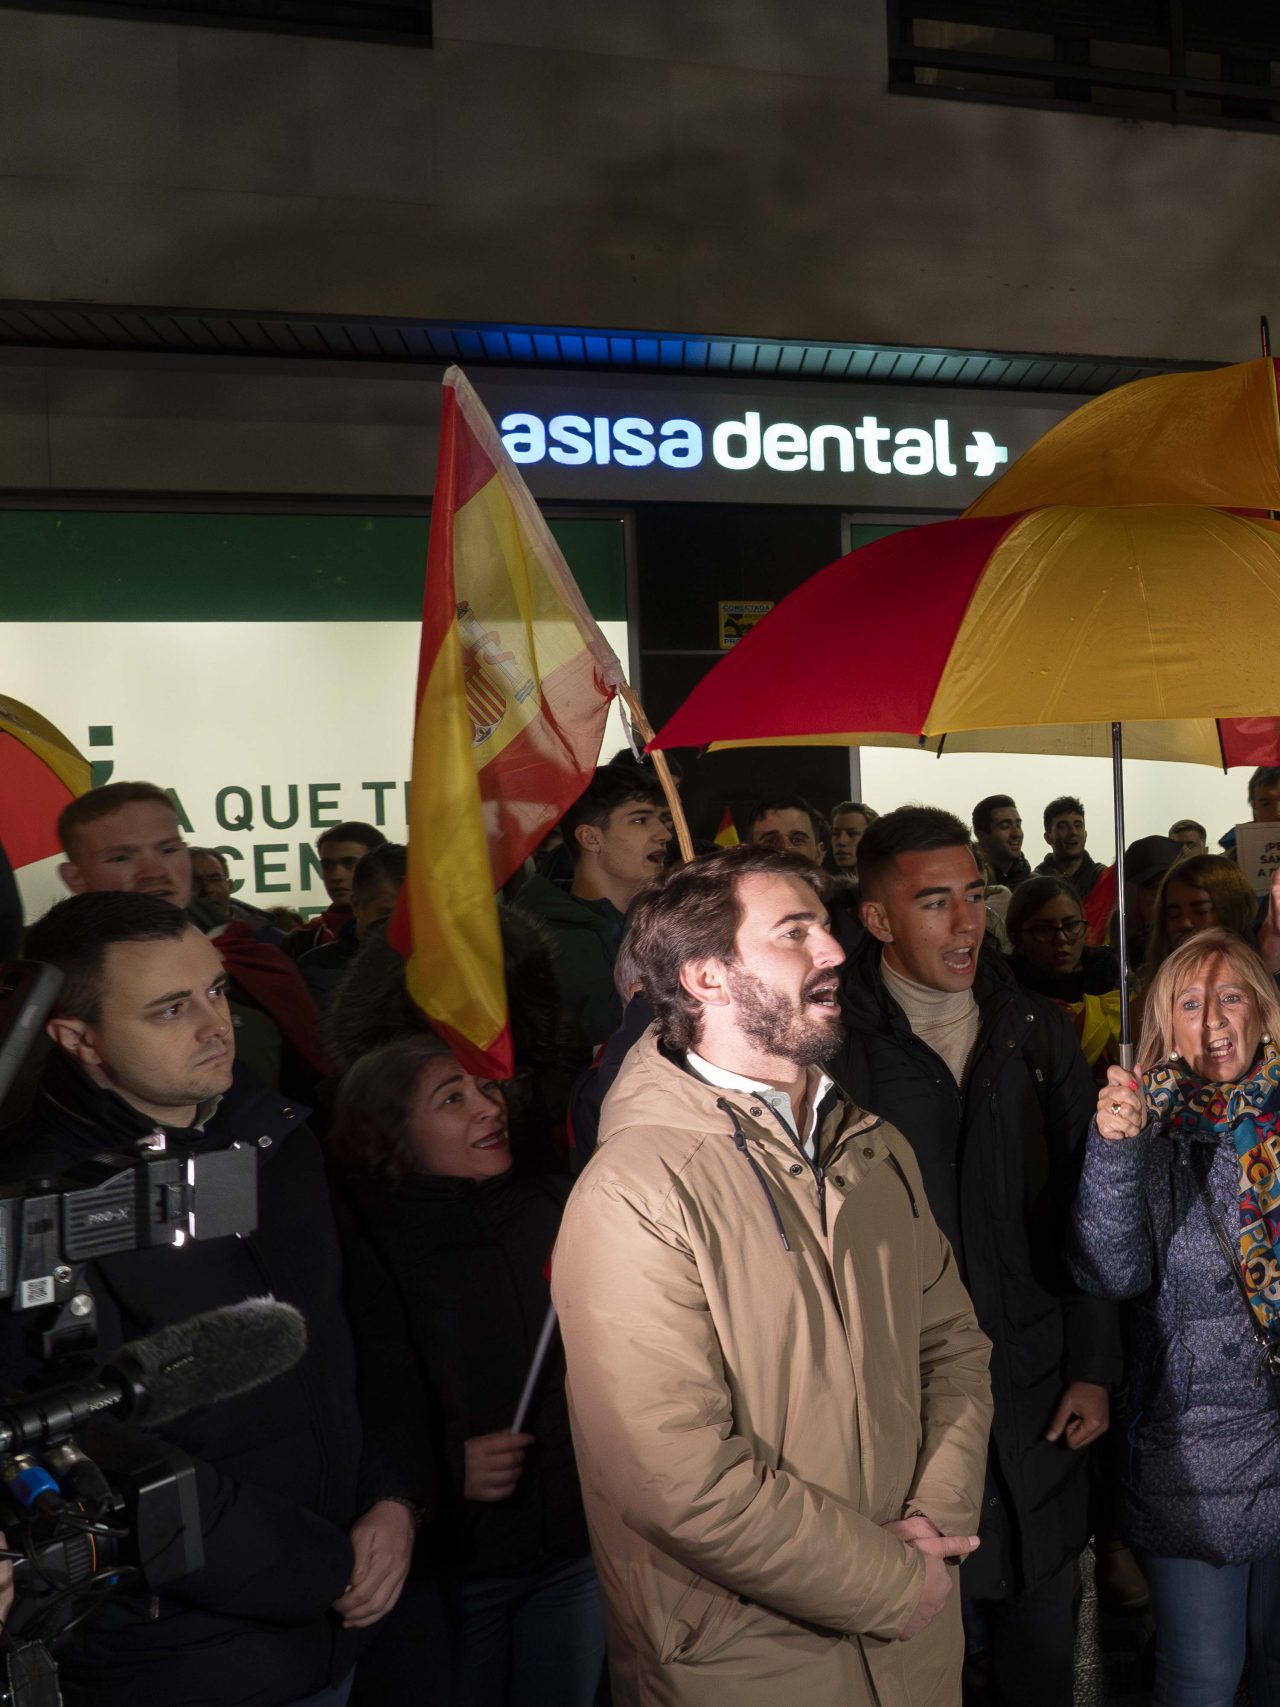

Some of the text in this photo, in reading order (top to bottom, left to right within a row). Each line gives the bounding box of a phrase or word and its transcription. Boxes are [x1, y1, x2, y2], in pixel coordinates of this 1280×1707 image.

[500, 411, 957, 476] asisa dental
[215, 782, 342, 832] QUE
[361, 781, 412, 826] T
